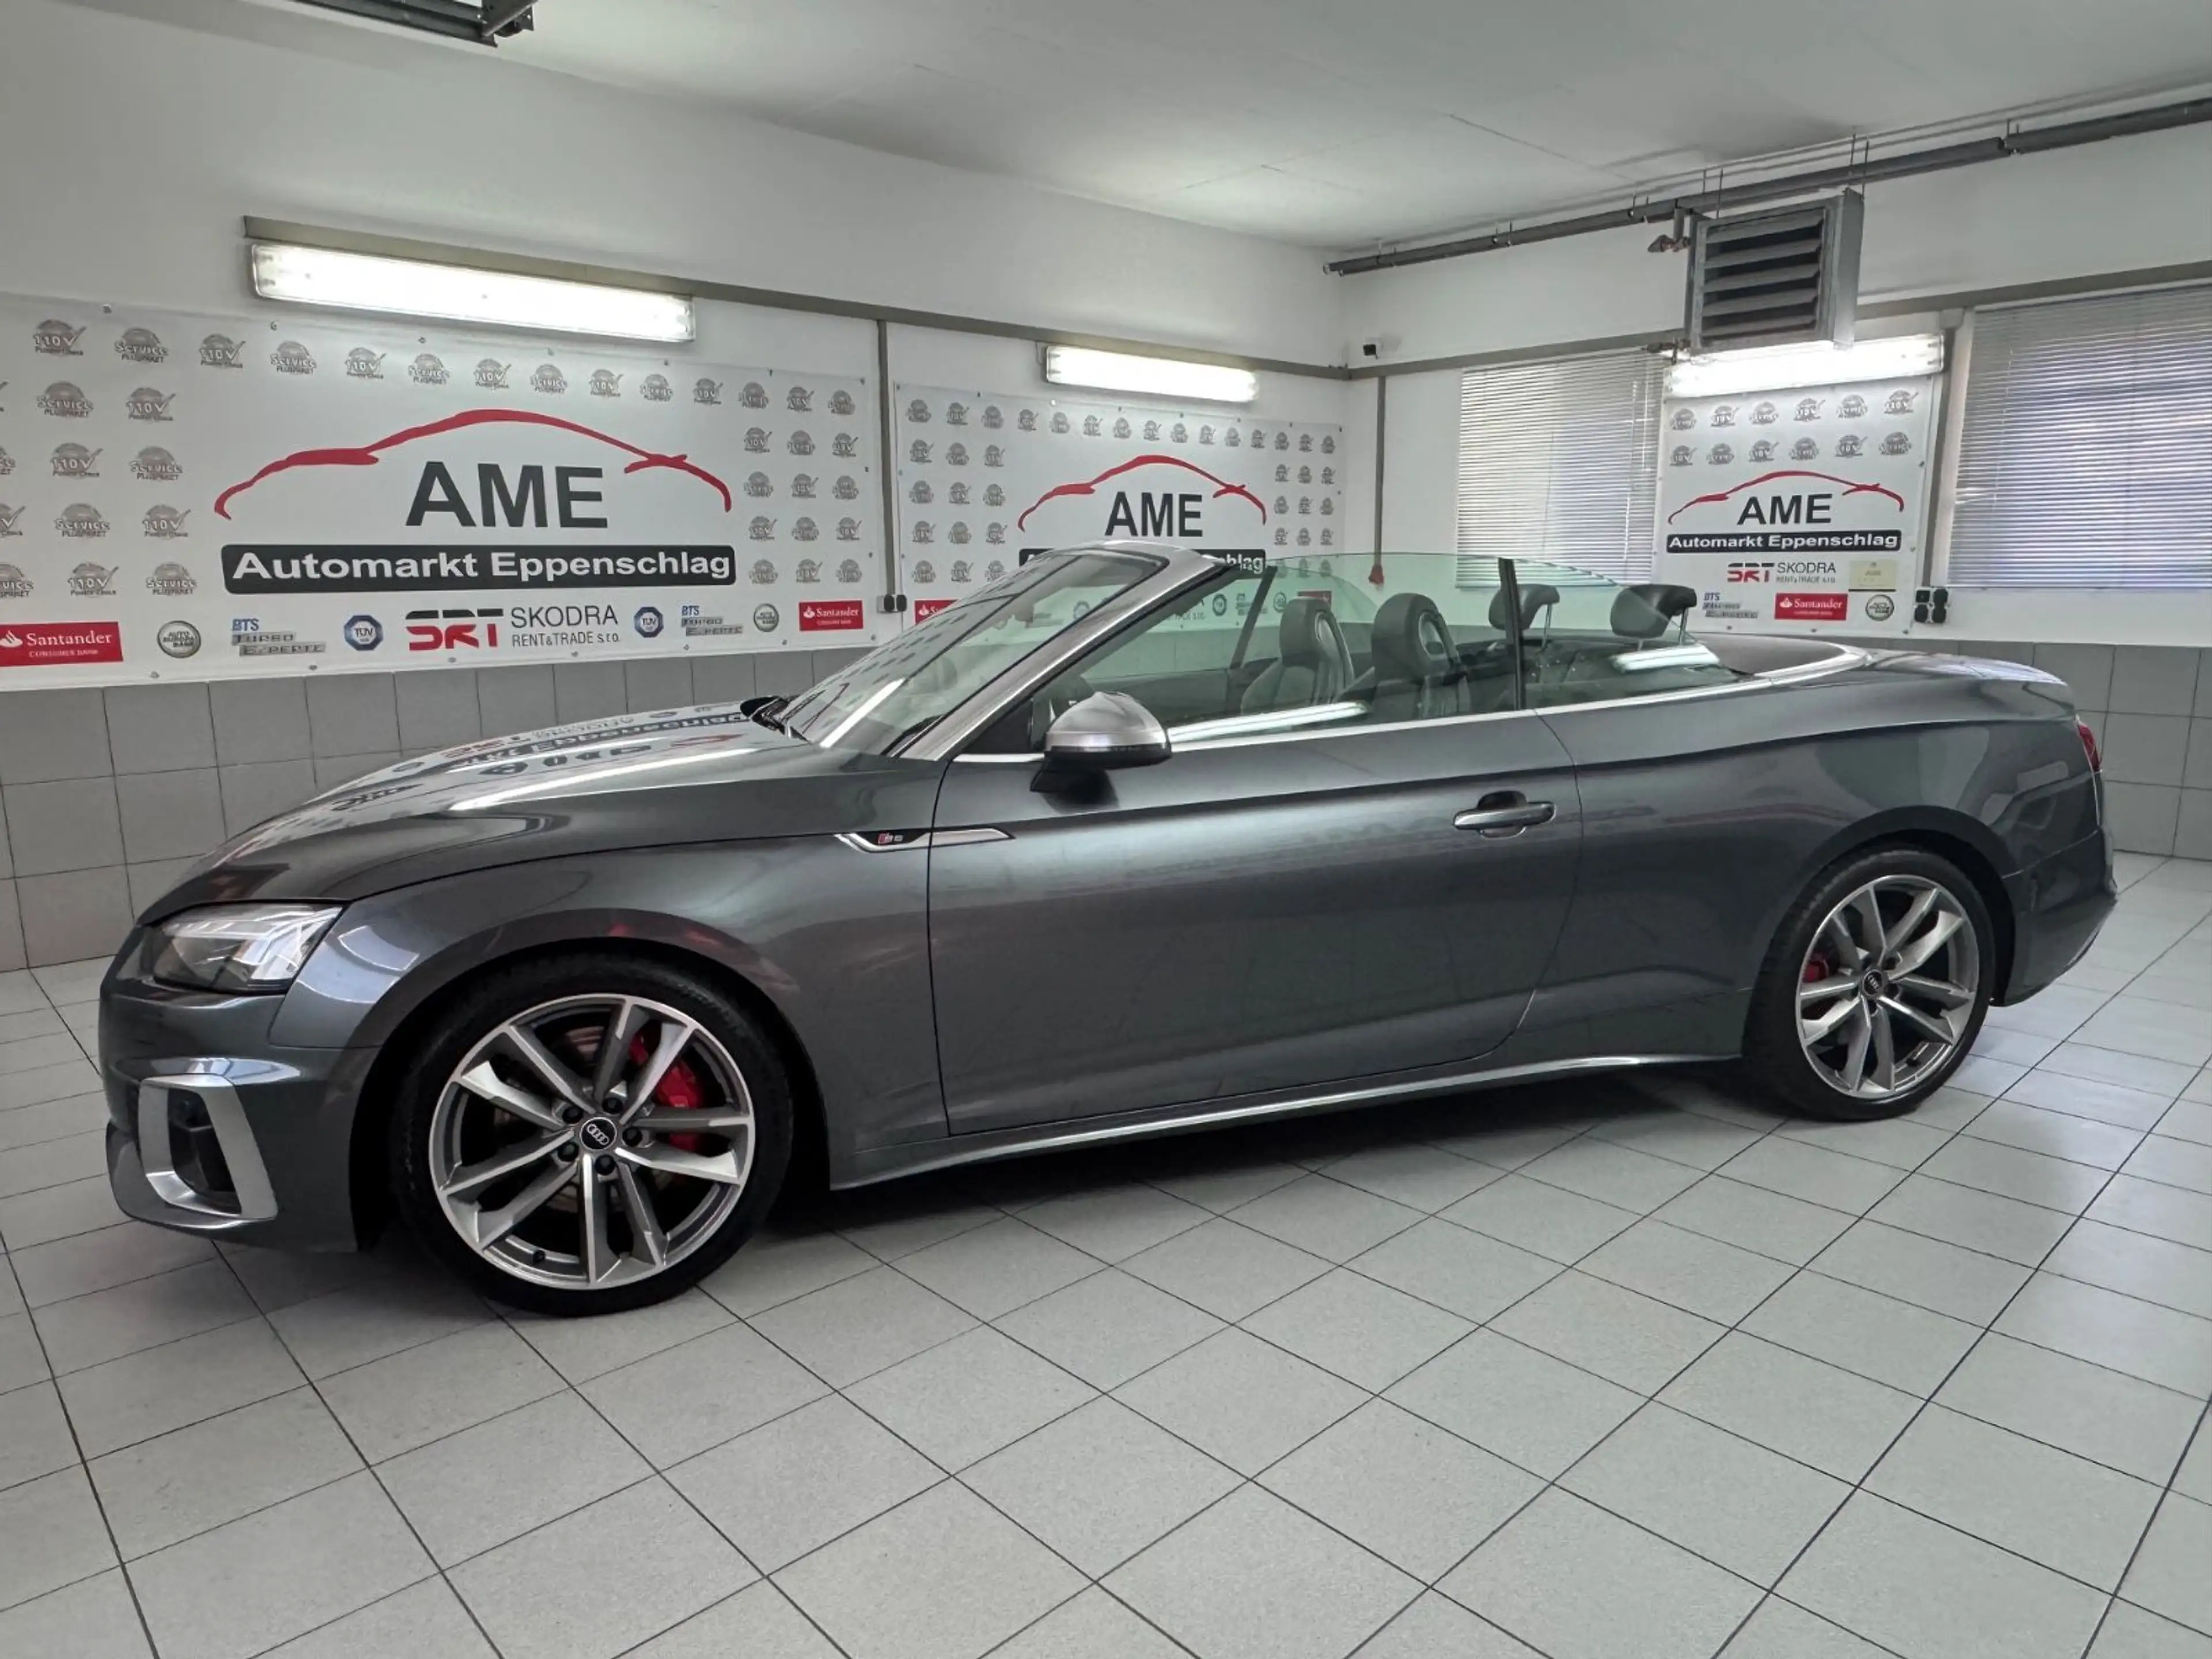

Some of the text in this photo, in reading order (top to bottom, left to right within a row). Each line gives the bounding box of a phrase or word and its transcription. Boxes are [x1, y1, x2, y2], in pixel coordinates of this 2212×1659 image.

[405, 461, 608, 528] AME
[1104, 491, 1203, 537] AME
[1736, 493, 1834, 525] AME
[1668, 533, 1898, 550] Automarkt Eppenschlag
[233, 551, 478, 580] Automarkt
[491, 551, 730, 581] Eppenschlag
[1777, 562, 1836, 574] SKODRA
[681, 605, 699, 616] BTS
[1794, 598, 1843, 609] Santander
[511, 605, 619, 628] SKODRA
[816, 606, 859, 618] Santander
[233, 618, 260, 631] BTS
[27, 631, 112, 646] Santander
[512, 631, 593, 647] RENT&TRADE
